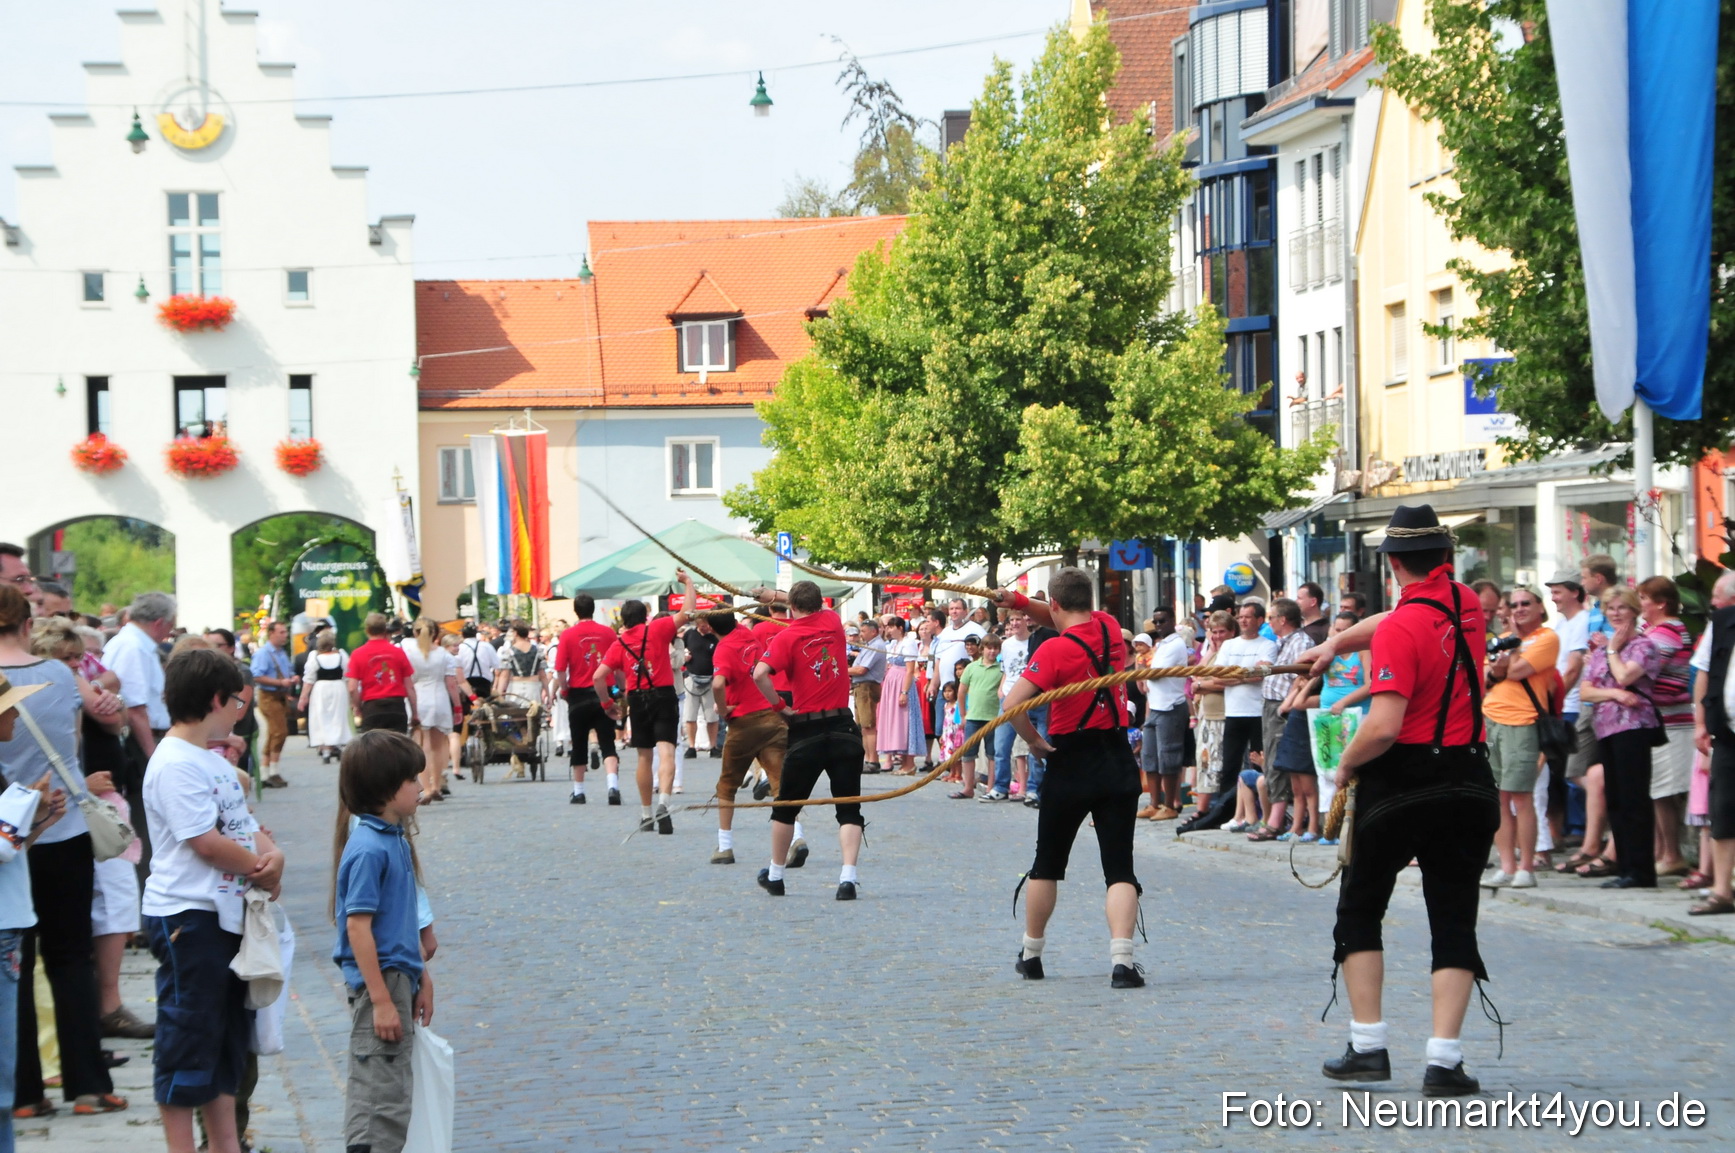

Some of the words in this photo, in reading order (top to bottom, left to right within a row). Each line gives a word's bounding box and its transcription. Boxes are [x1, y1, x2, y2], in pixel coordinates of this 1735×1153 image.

[780, 535, 790, 556] P
[301, 561, 368, 573] Naturgenuss
[320, 574, 348, 585] ohne
[1228, 573, 1254, 581] Thomas
[299, 588, 371, 599] Kompromisse
